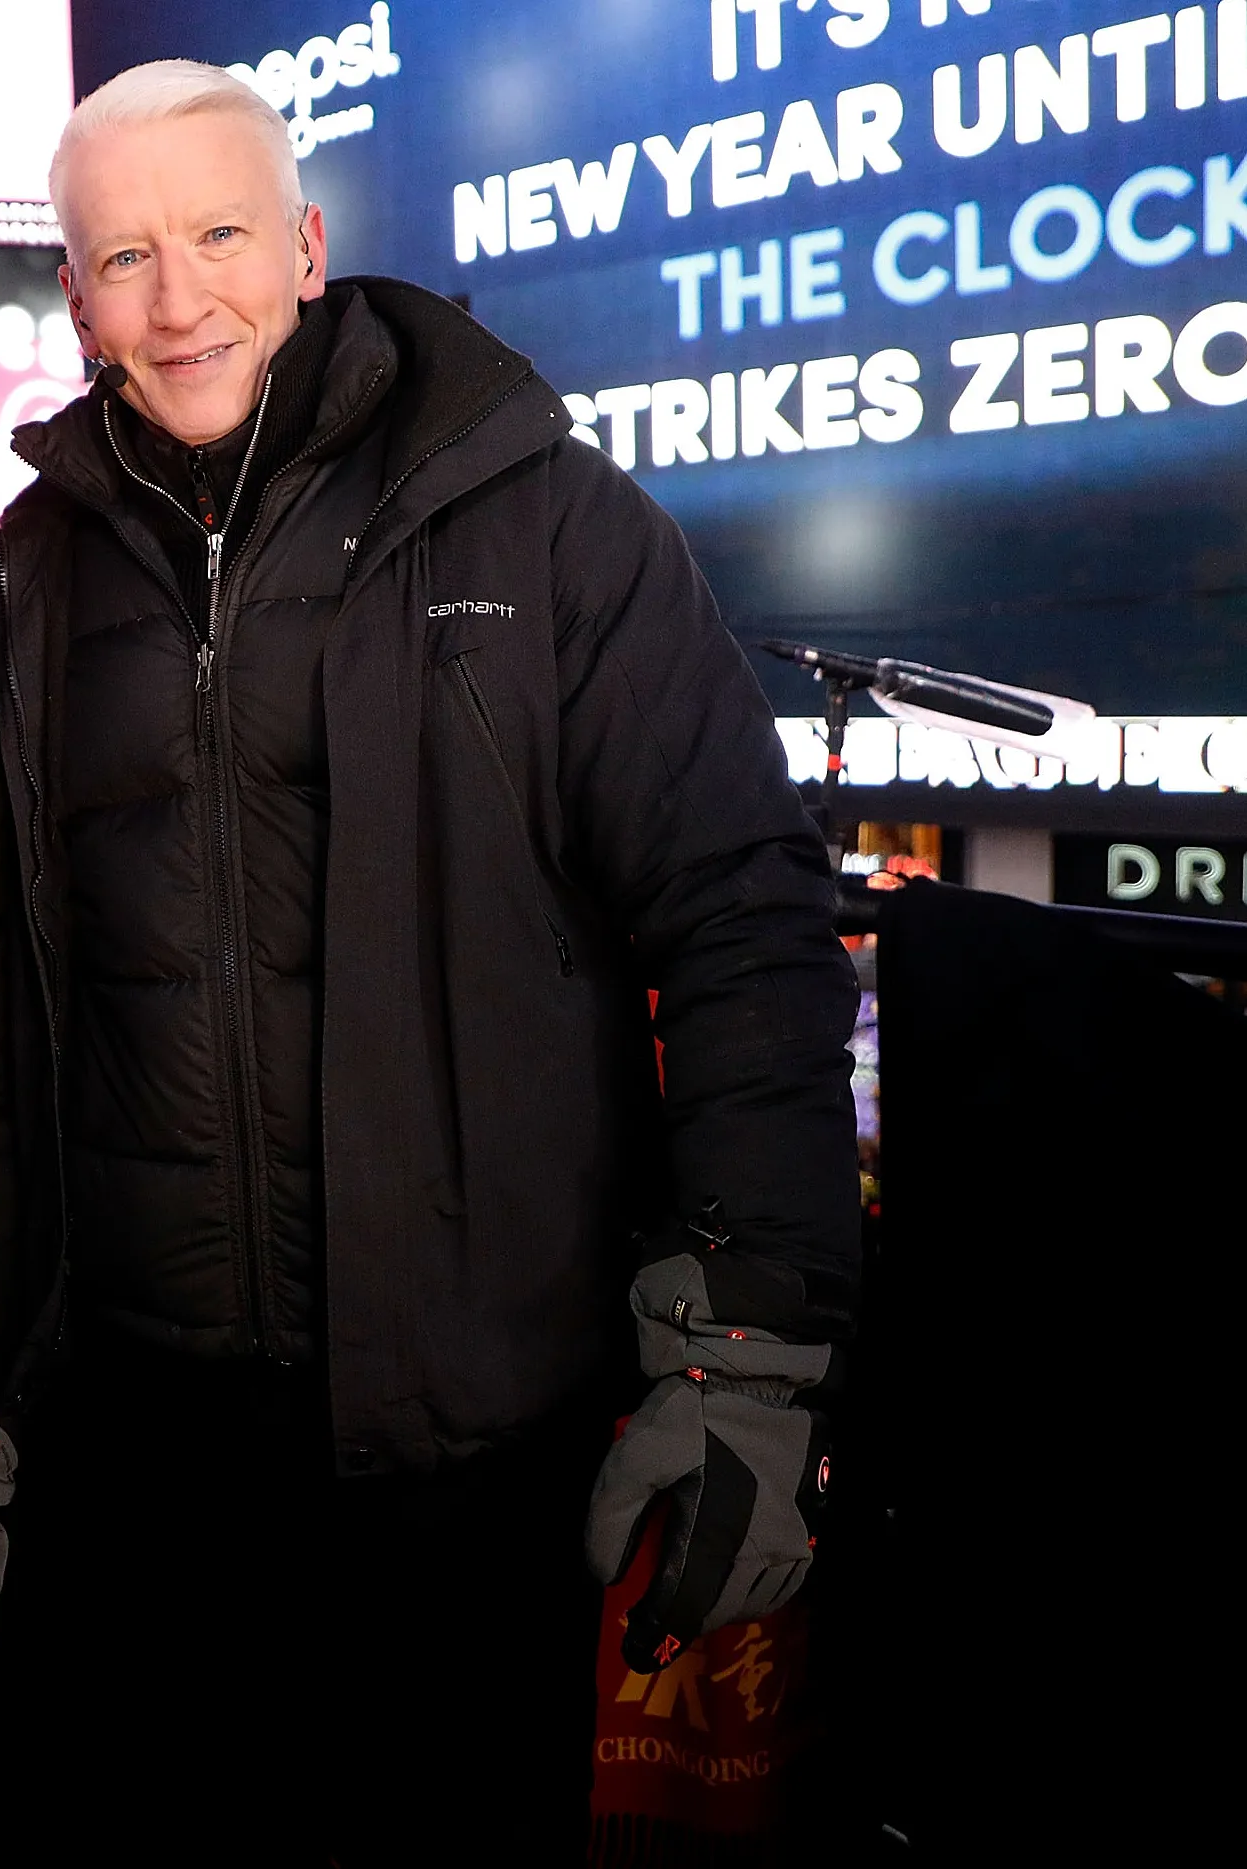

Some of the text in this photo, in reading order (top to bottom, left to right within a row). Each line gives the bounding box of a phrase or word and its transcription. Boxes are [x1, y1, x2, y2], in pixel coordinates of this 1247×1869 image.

[453, 142, 637, 264] NEW
[642, 82, 903, 218] YEAR
[661, 152, 1247, 341] THE CLOCK
[949, 301, 1247, 434] ZERO
[428, 600, 516, 619] carhartt
[1107, 842, 1247, 904] DR
[596, 1735, 771, 1787] CHONGQING
